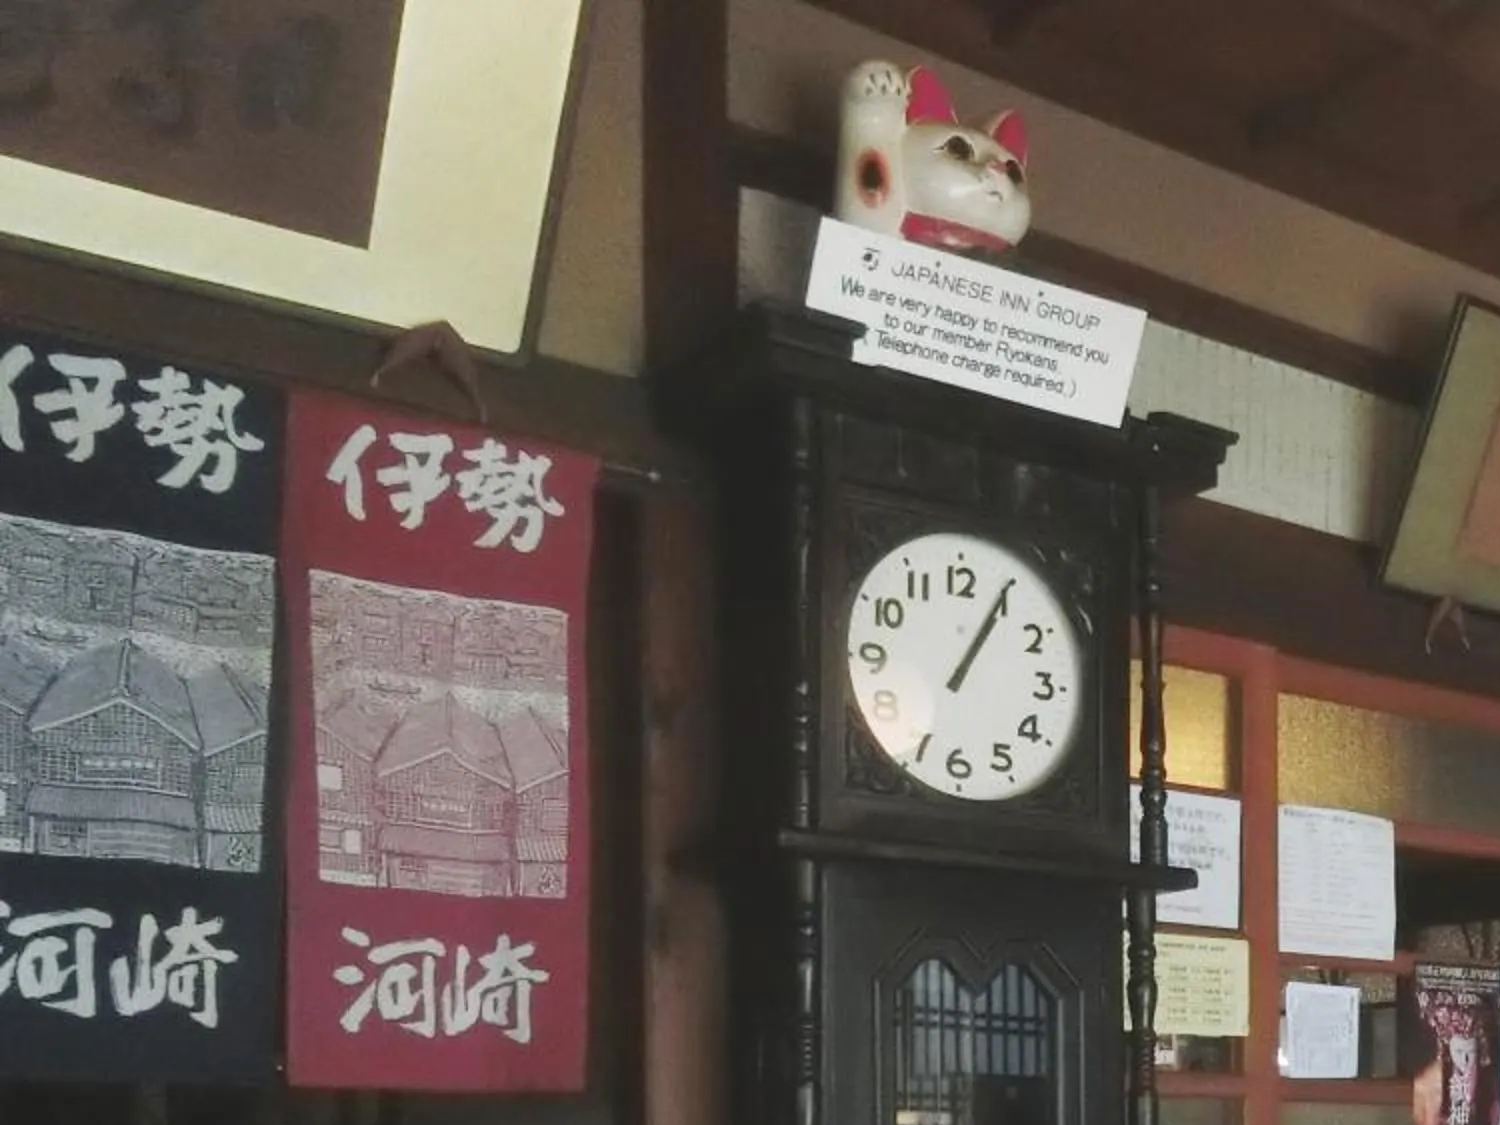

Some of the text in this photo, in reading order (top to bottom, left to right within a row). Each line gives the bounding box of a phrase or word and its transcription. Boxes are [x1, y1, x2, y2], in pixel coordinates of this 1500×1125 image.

[891, 261, 1101, 331] JAPANESE INN GROUP
[841, 274, 1109, 365] We are very happy to recommend you
[884, 313, 899, 329] to
[904, 320, 928, 335] our
[932, 326, 992, 352] member
[951, 354, 1001, 379] charge
[0, 344, 264, 494] 伊勢
[326, 424, 565, 553] 伊勢
[908, 570, 929, 601] 11
[947, 565, 977, 598] 12
[875, 597, 904, 629] 10
[1023, 623, 1043, 654] 2
[859, 642, 887, 675] 9
[1033, 671, 1055, 701] 3
[872, 689, 898, 722] 8
[1017, 714, 1042, 743] 4
[946, 748, 972, 779] 6
[990, 743, 1013, 773] 5
[0, 906, 238, 1029] 河崎
[333, 926, 550, 1045] 河崎
